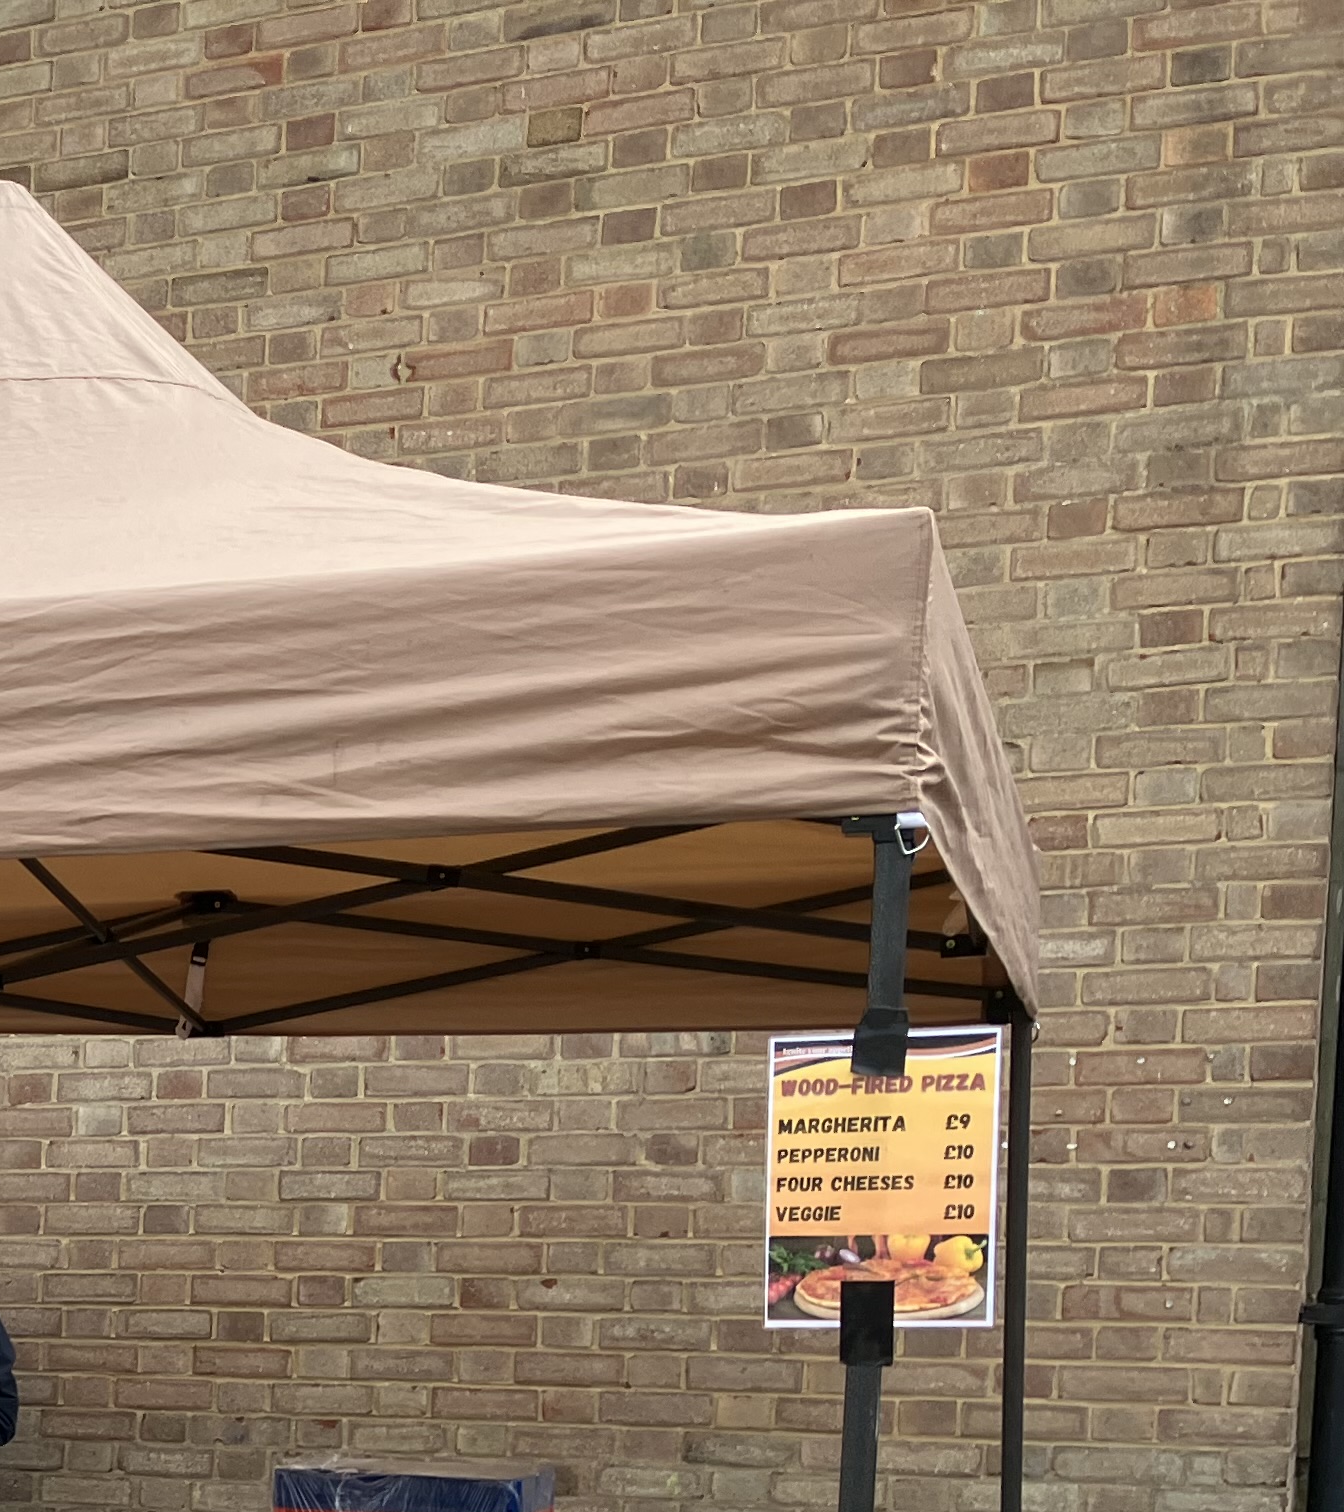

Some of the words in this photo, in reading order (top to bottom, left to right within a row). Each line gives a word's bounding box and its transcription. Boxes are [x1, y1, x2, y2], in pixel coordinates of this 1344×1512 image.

[781, 1075, 914, 1097] WOOD-FIRED
[921, 1073, 987, 1092] PIZZA
[778, 1116, 907, 1135] MARGHERITA
[945, 1113, 971, 1130] £9
[777, 1146, 880, 1164] PEPPERONI
[943, 1145, 975, 1160] £10
[776, 1177, 823, 1193] FOUR
[830, 1175, 915, 1191] CHEESES
[943, 1174, 975, 1190] £10
[776, 1206, 842, 1222] VEGGIE
[943, 1204, 976, 1220] £10
